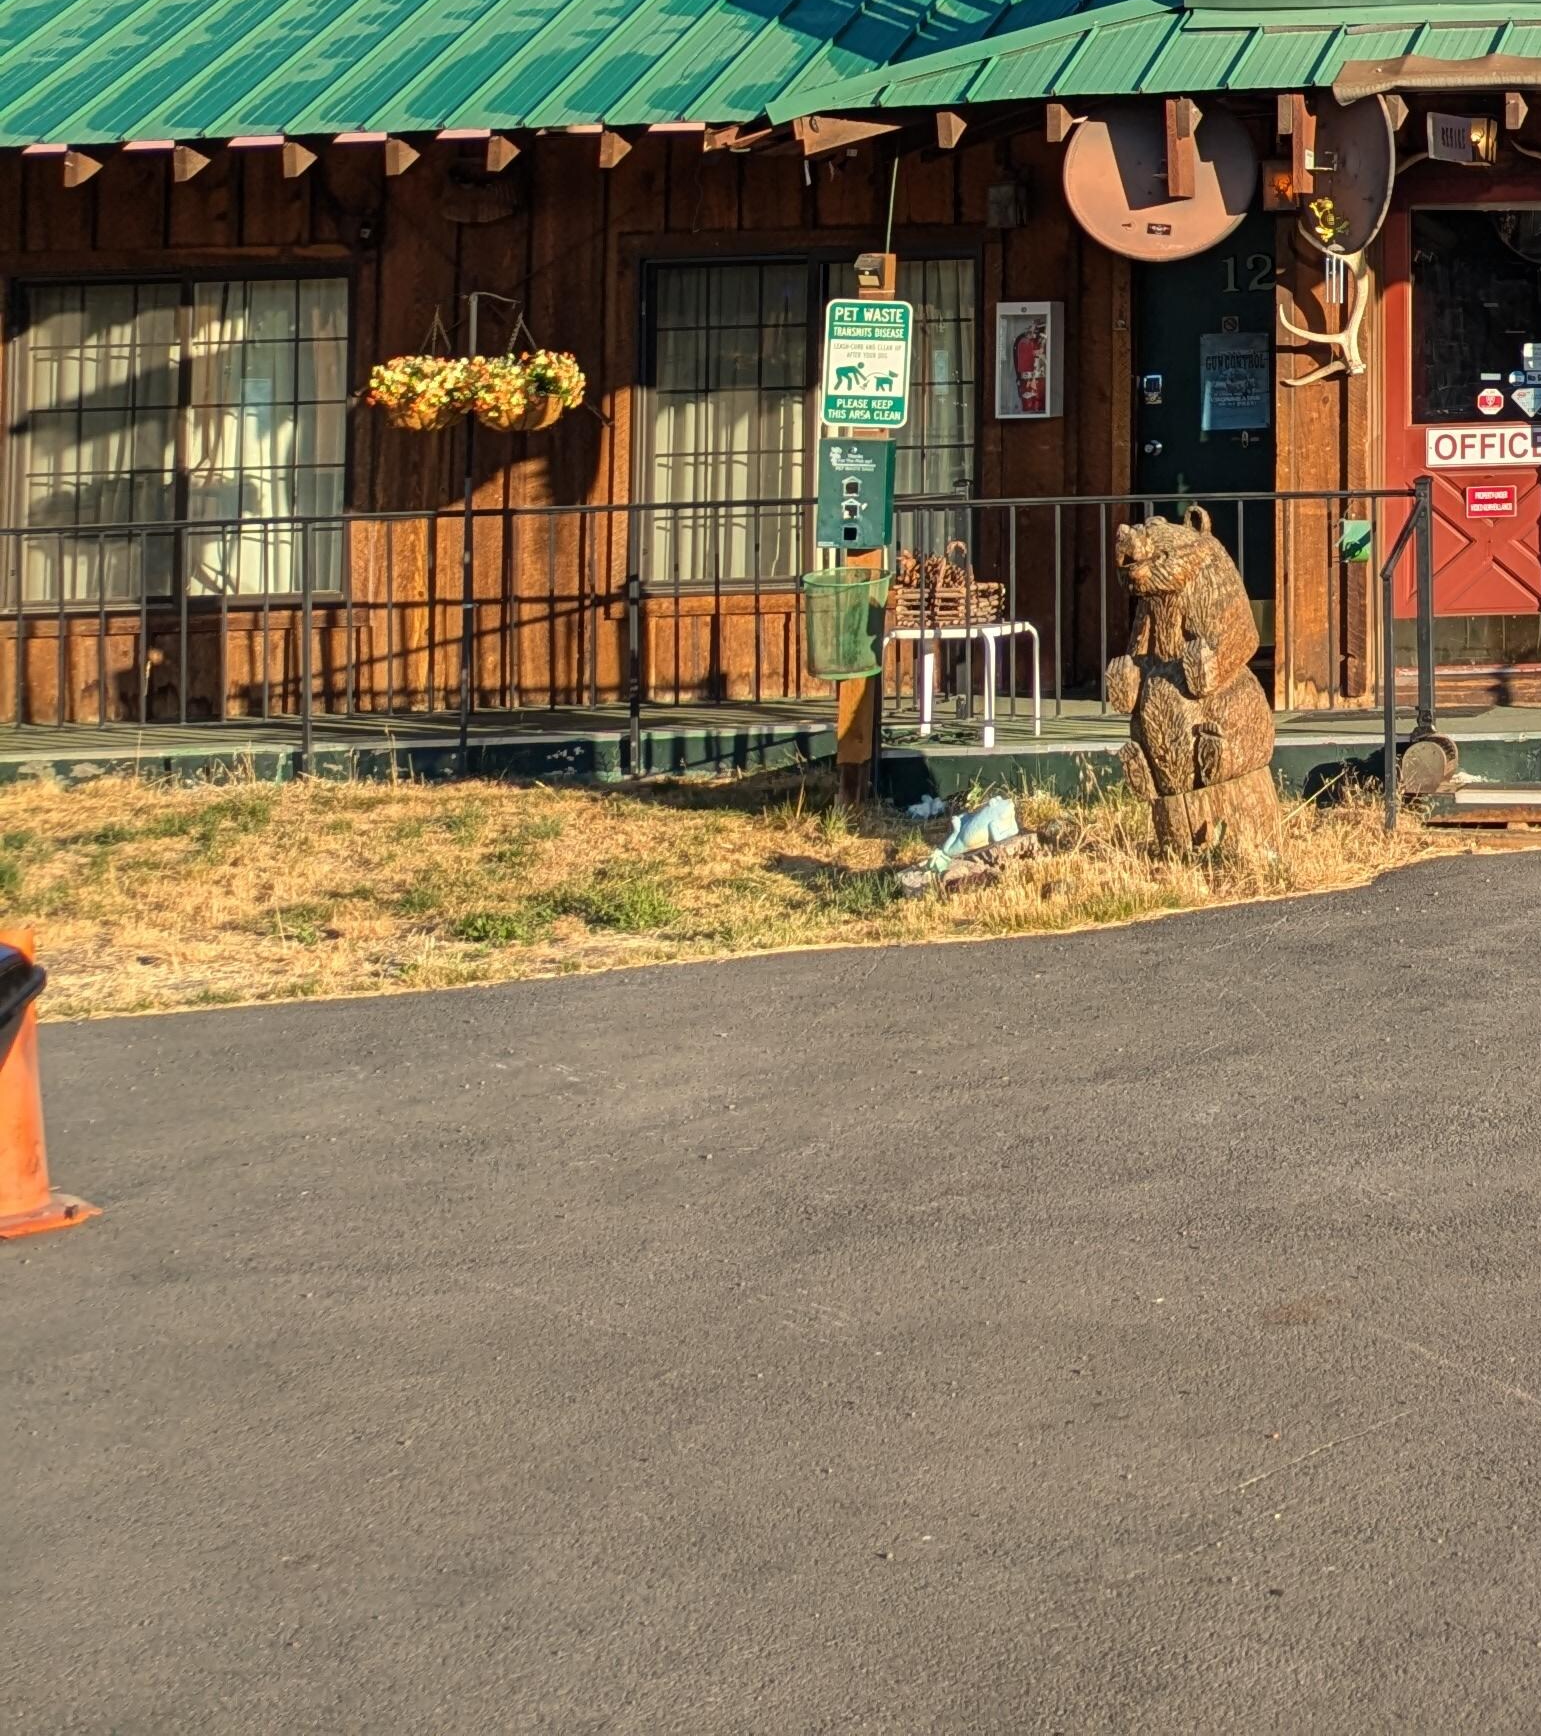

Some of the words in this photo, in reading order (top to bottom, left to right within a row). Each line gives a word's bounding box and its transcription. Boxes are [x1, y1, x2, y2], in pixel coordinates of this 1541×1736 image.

[1222, 253, 1276, 293] 12
[834, 307, 859, 321] PET
[863, 308, 904, 322] WASTE
[833, 326, 872, 337] TRANSMITS
[875, 328, 904, 338] DISEASE
[836, 398, 868, 409] PLEASE
[871, 399, 894, 410] KEEP
[828, 409, 847, 419] THIS
[848, 409, 871, 420] AREA
[873, 410, 901, 421] CLEAN
